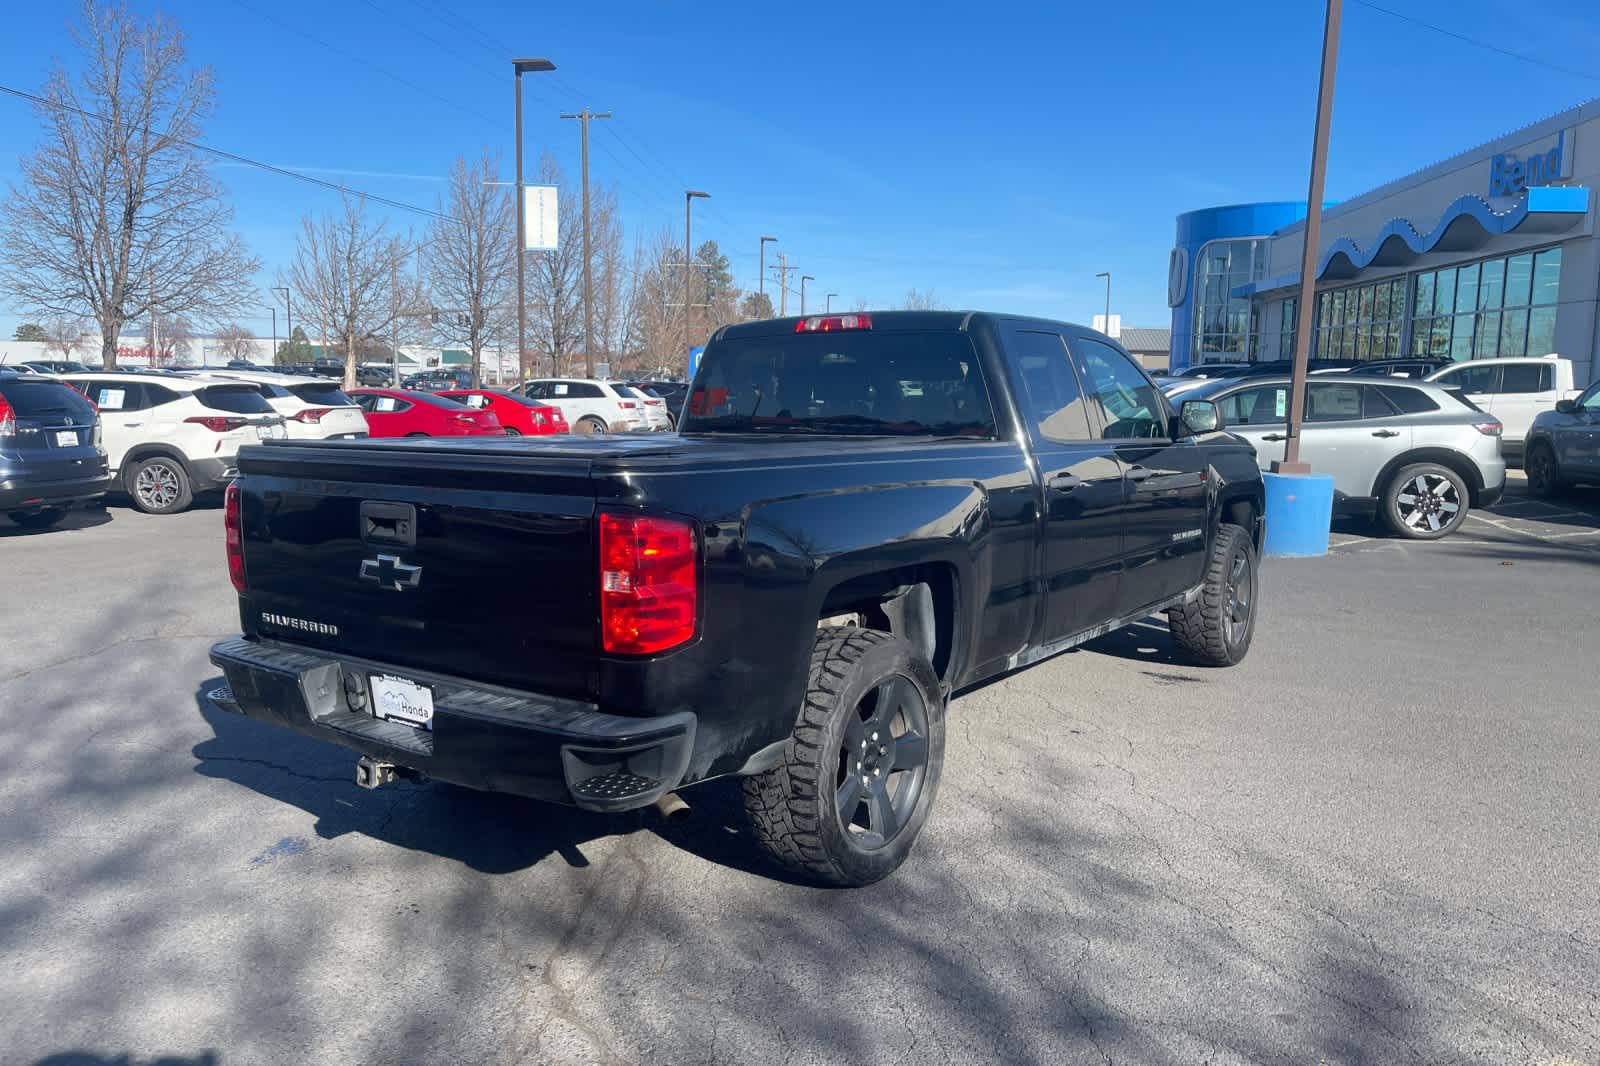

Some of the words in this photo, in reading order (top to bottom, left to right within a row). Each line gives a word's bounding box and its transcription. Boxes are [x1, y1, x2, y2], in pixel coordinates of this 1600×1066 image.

[1490, 130, 1564, 195] Bend
[262, 612, 338, 635] SILVERADO
[402, 702, 429, 718] Honda
